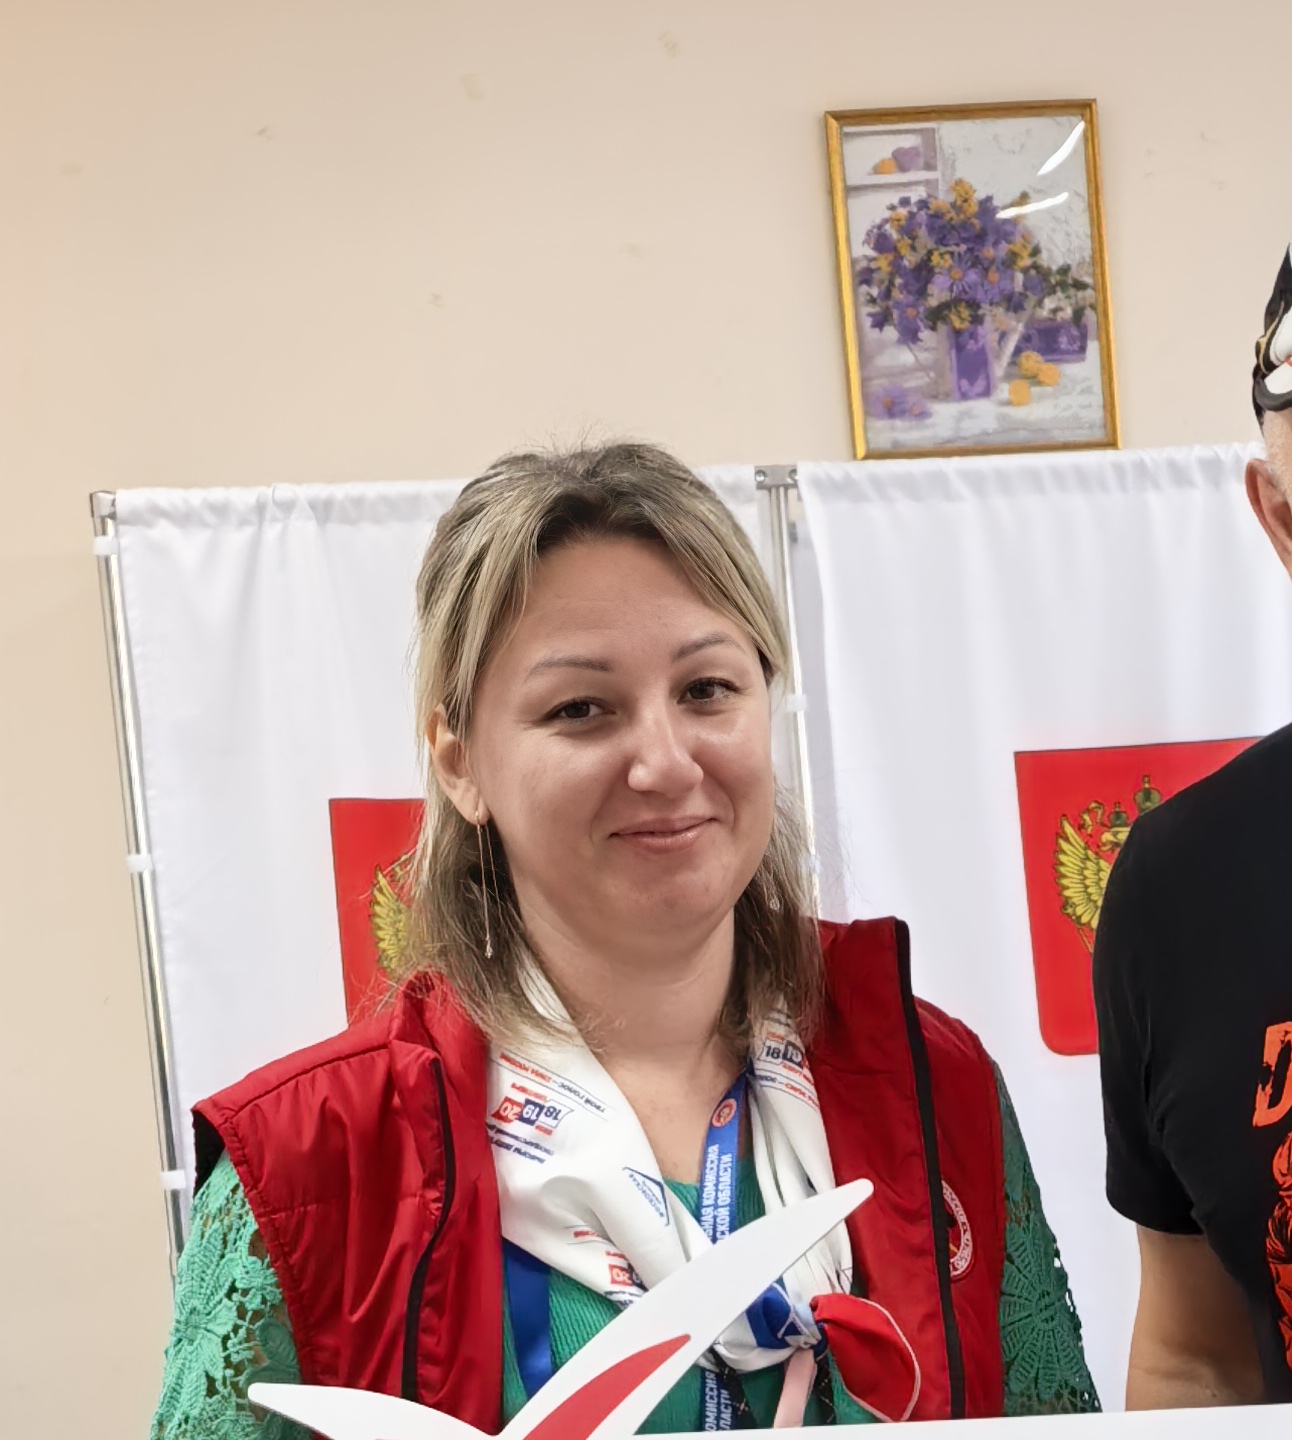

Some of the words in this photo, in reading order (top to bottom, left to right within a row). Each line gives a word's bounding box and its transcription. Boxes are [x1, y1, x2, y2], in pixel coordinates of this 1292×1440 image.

[765, 1046, 781, 1059] 18
[500, 1102, 521, 1120] 20
[522, 1102, 540, 1120] 19
[544, 1106, 562, 1121] 18
[702, 1144, 719, 1205] КОМИССИЯ
[717, 1153, 732, 1205] ОБЛАСТИ
[700, 1206, 714, 1239] ЬНАЯ
